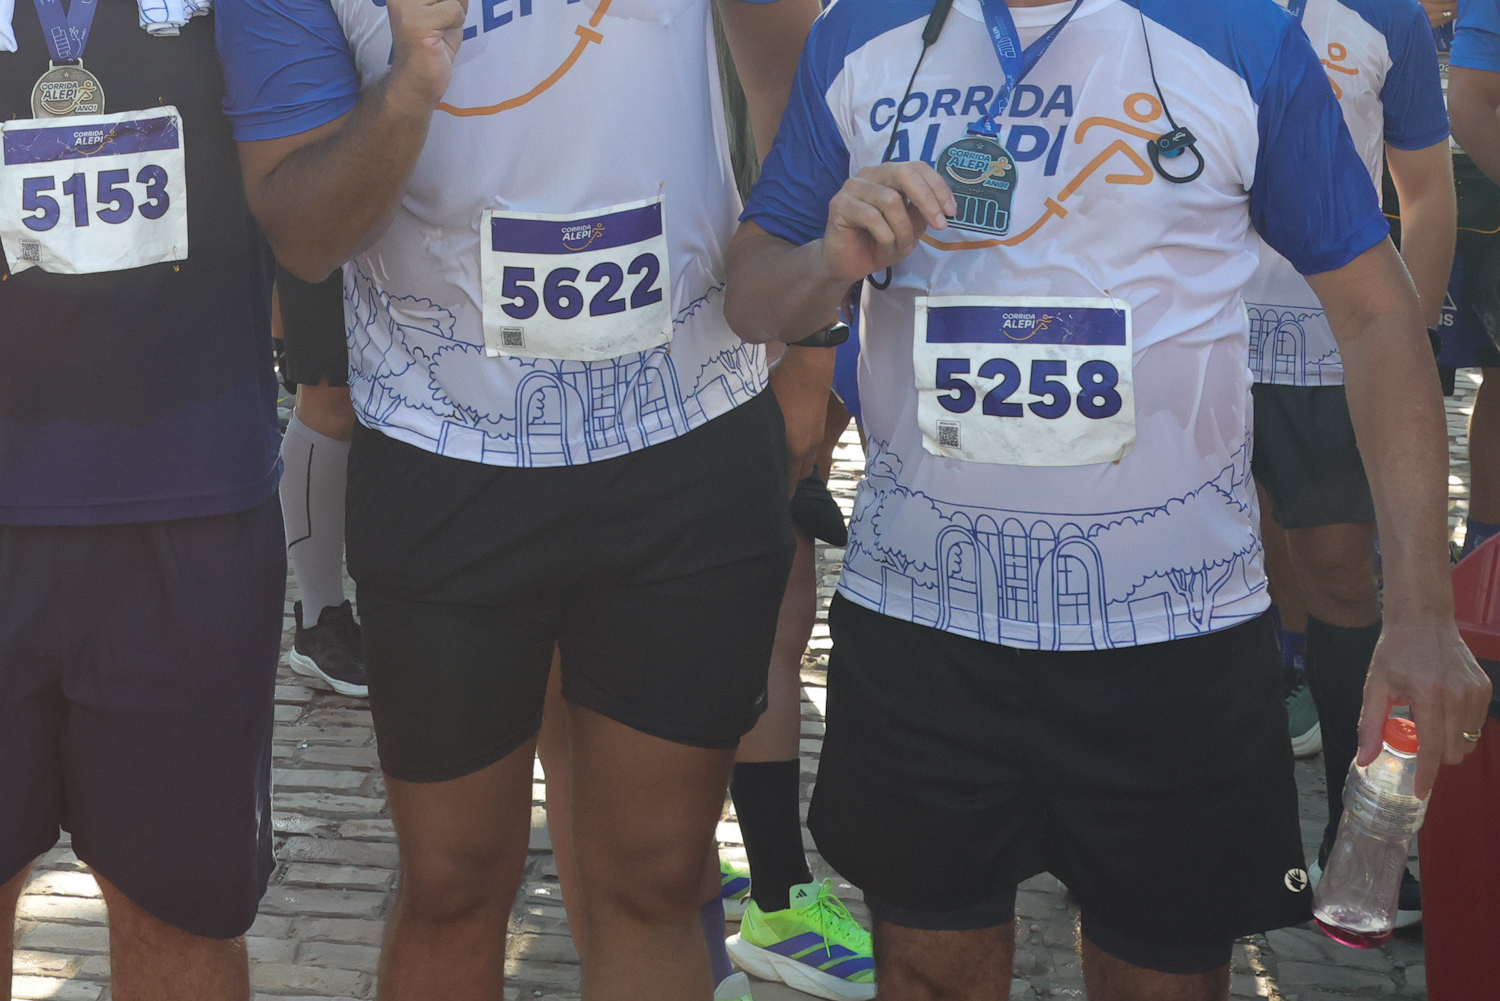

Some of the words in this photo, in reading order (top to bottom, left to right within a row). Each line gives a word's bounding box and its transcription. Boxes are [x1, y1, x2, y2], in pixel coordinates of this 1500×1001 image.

[41, 81, 78, 91] CORRIDA
[42, 89, 78, 101] ALEPI
[73, 130, 104, 138] CORRIDA
[74, 136, 104, 146] ALEPI
[948, 148, 991, 162] CORRIDA
[948, 156, 989, 172] ALEPI
[21, 164, 170, 232] 5153
[561, 224, 592, 233] CORRIDA
[562, 230, 591, 241] ALEPI
[500, 252, 663, 320] 5622
[1003, 319, 1036, 328] ALEPI
[936, 358, 1122, 420] 5258
